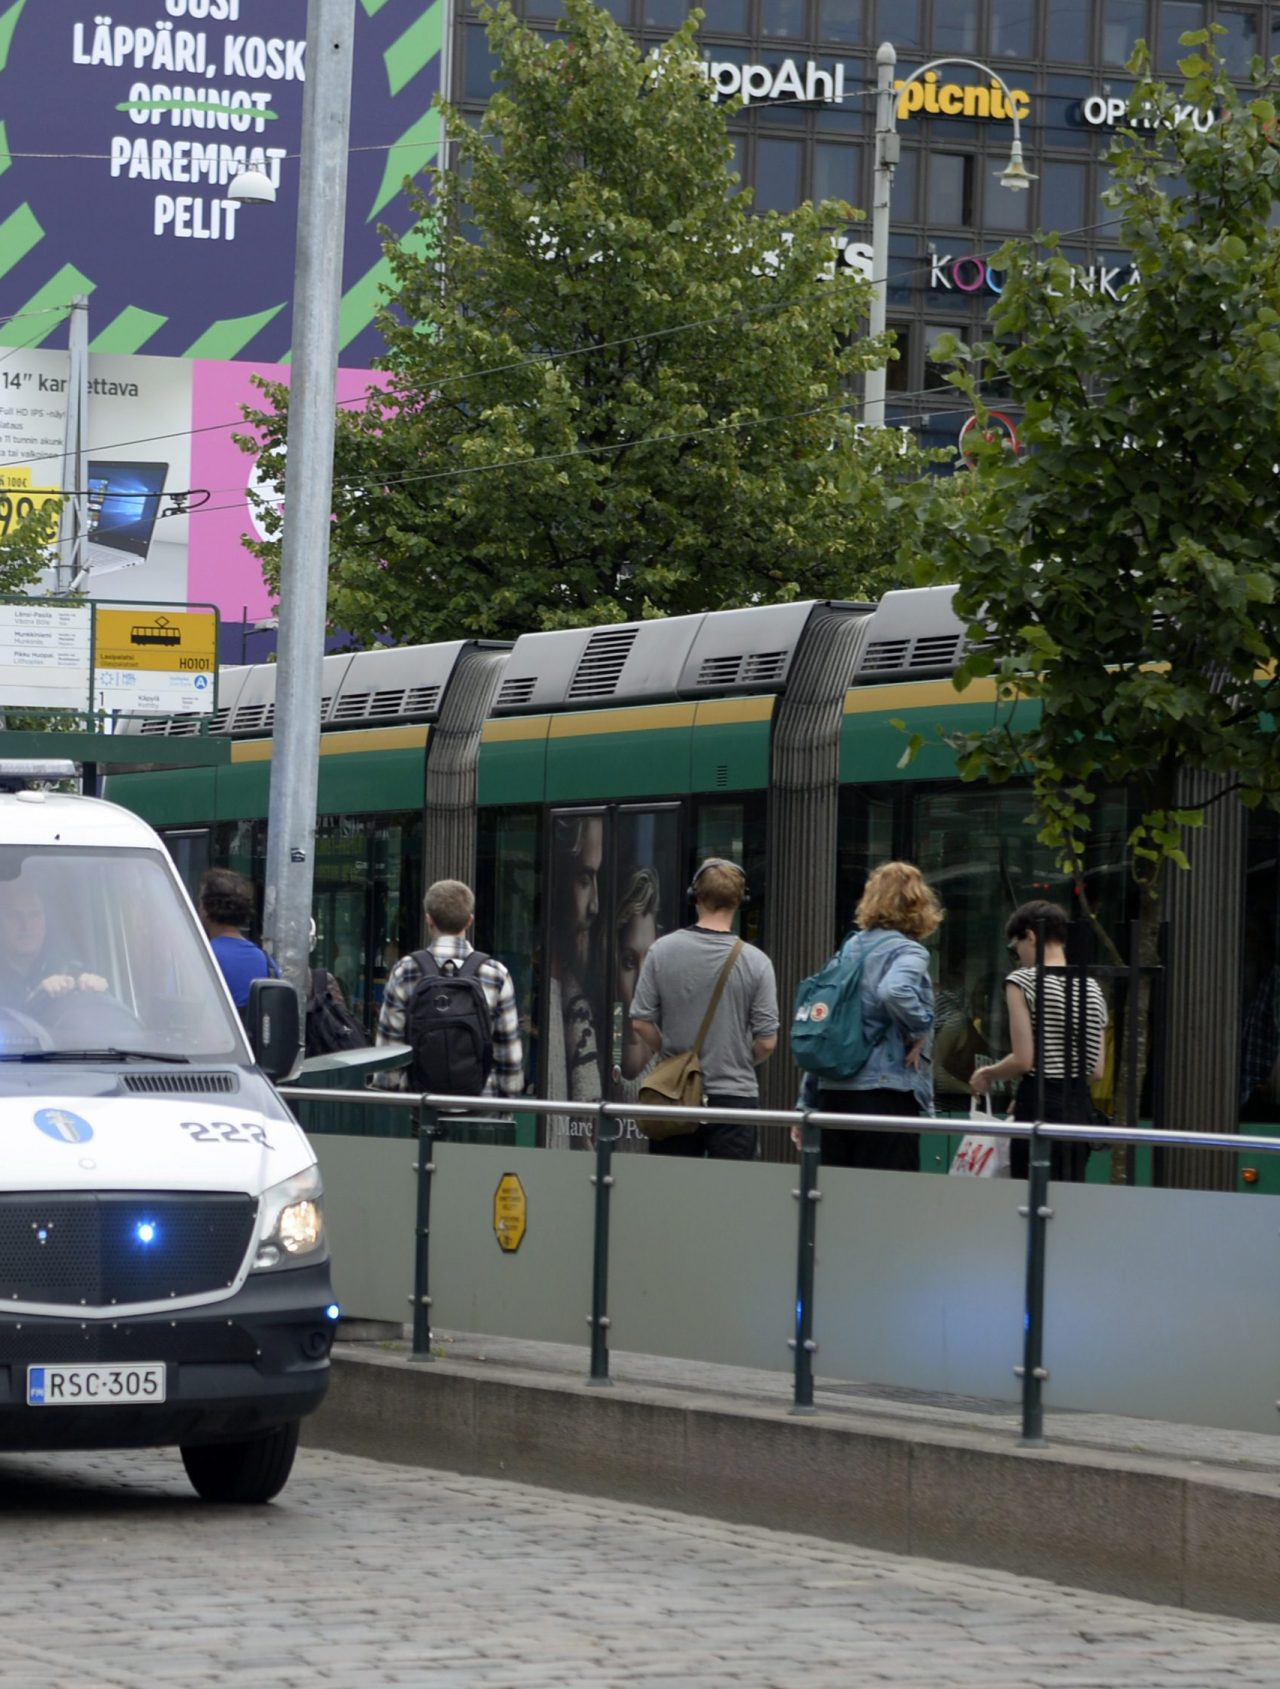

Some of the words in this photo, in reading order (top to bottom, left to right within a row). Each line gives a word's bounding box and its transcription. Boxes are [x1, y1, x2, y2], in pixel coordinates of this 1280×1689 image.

[73, 16, 216, 78] LÄPPÄRI,
[224, 35, 306, 81] KOSK
[128, 83, 272, 133] OPINNOT
[894, 71, 1030, 119] picnic
[110, 136, 287, 189] PAREMMAT
[154, 195, 241, 240] PELIT
[180, 658, 210, 670] H0101
